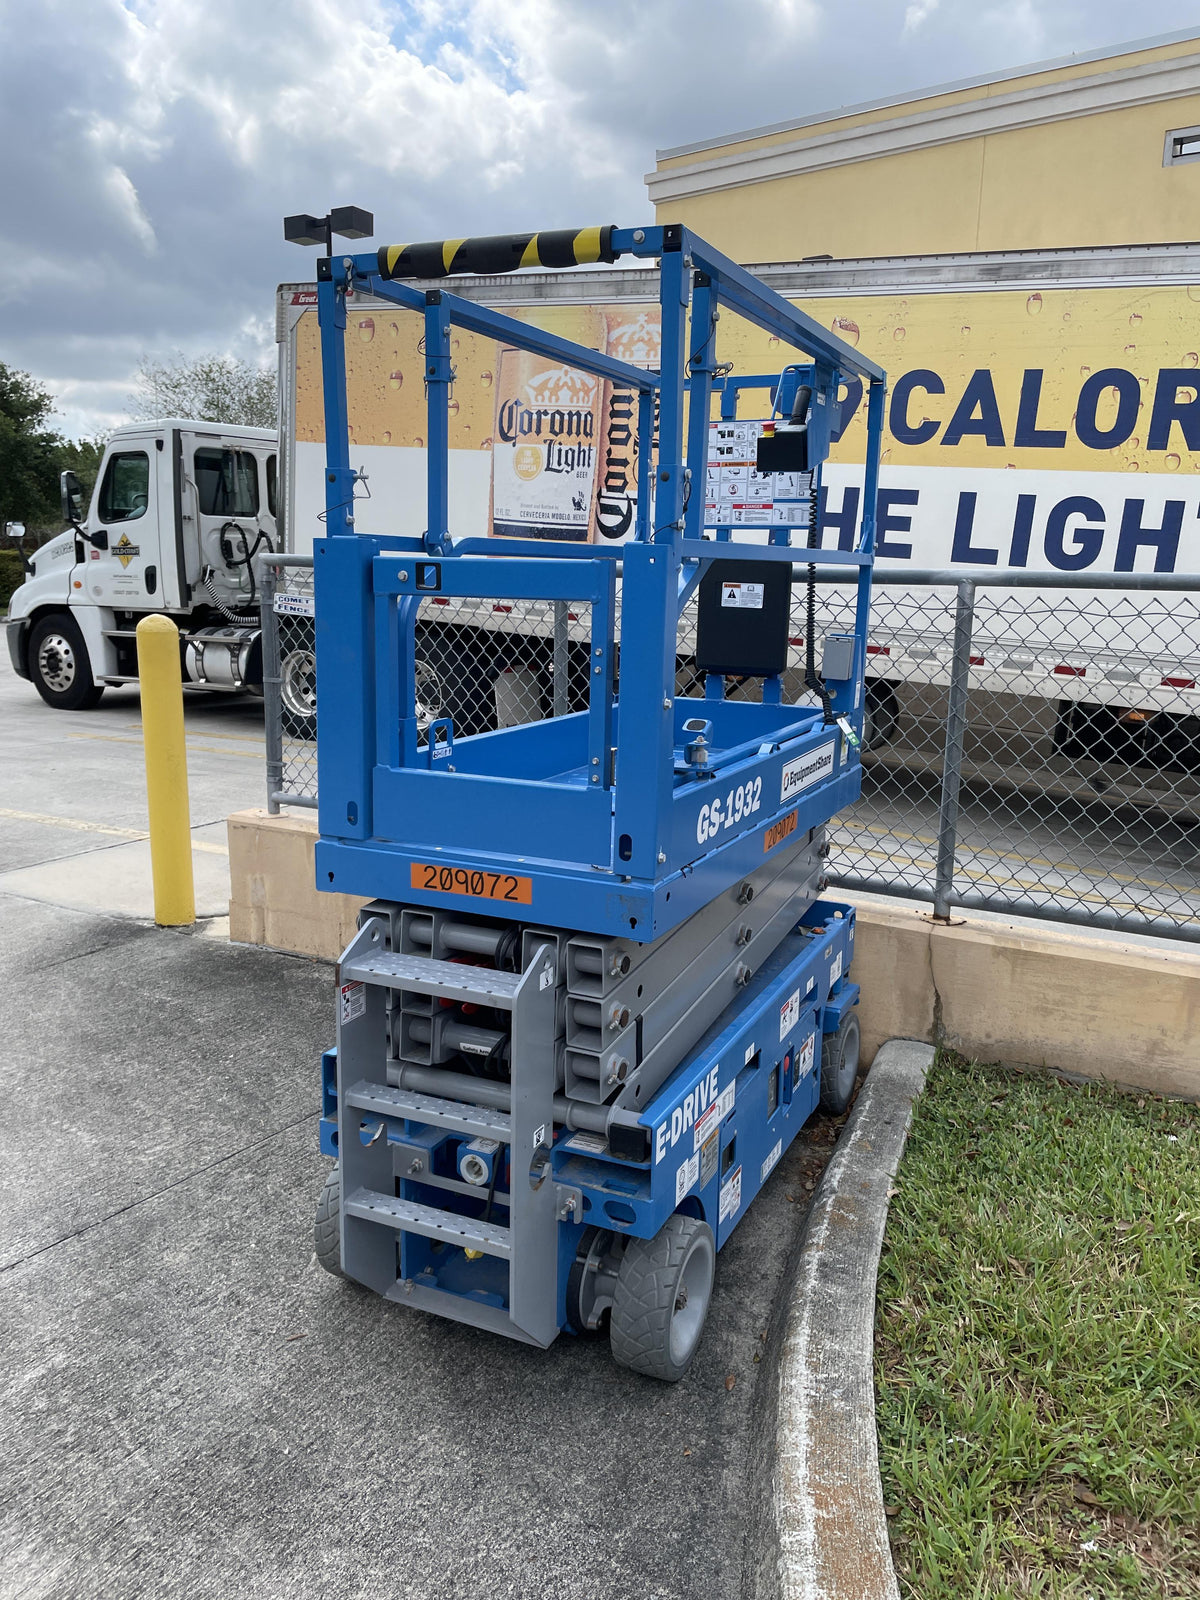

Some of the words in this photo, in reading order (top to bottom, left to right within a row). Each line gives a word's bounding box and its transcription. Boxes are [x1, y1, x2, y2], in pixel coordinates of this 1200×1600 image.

[499, 398, 594, 447] Corona
[543, 439, 593, 474] Light
[951, 491, 1200, 573] LIGH
[278, 595, 310, 604] COMET
[278, 603, 310, 614] FENCE
[790, 753, 832, 787] EquipmentShare
[696, 775, 762, 845] GS-1932
[423, 865, 519, 901] 209072
[655, 1063, 719, 1166] E-DRIVE
